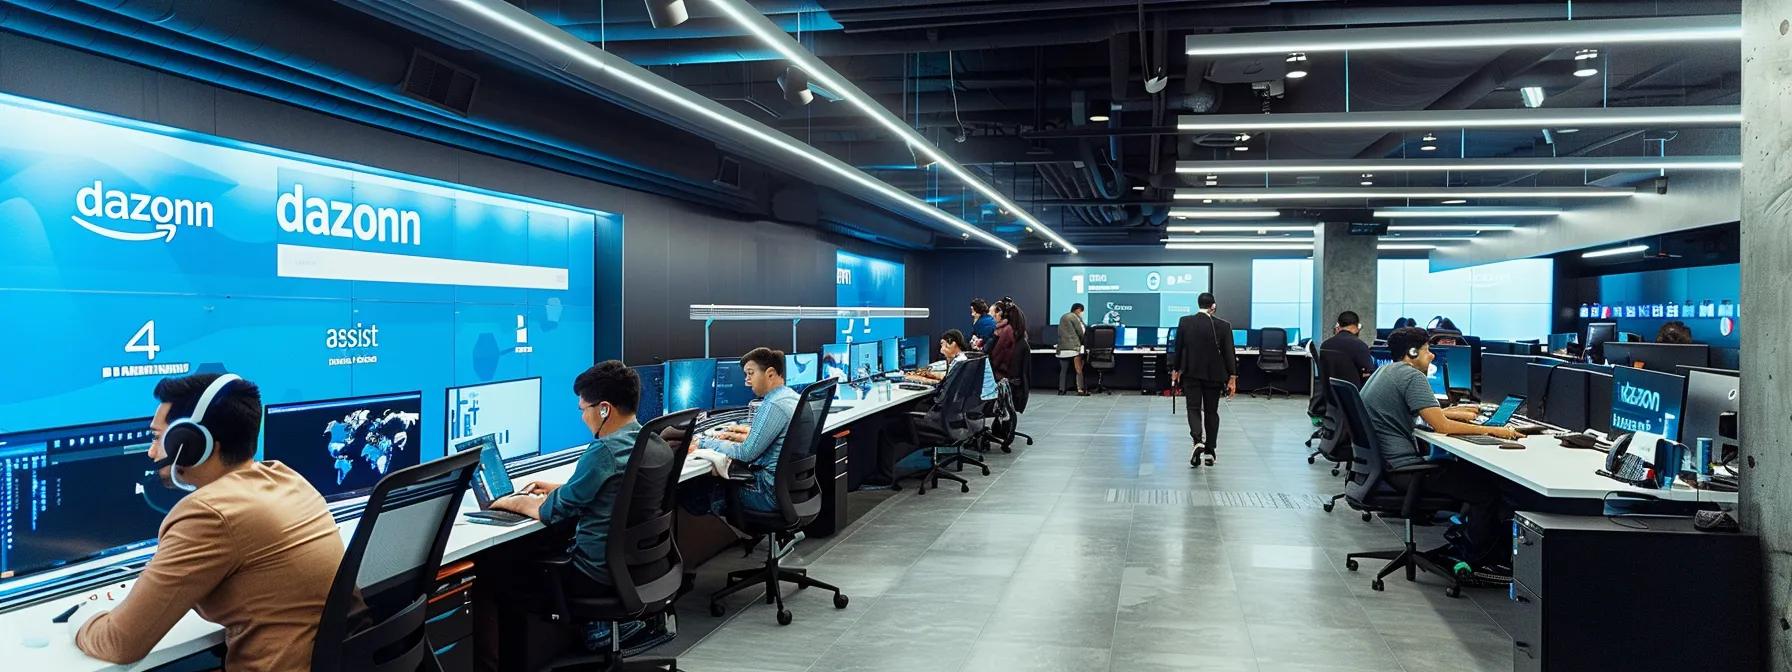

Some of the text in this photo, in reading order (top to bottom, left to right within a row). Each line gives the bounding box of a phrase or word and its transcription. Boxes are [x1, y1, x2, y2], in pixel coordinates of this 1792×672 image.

[75, 180, 214, 228] dazonn
[276, 184, 421, 246] dazonn
[124, 319, 161, 360] 4
[326, 322, 379, 349] assist
